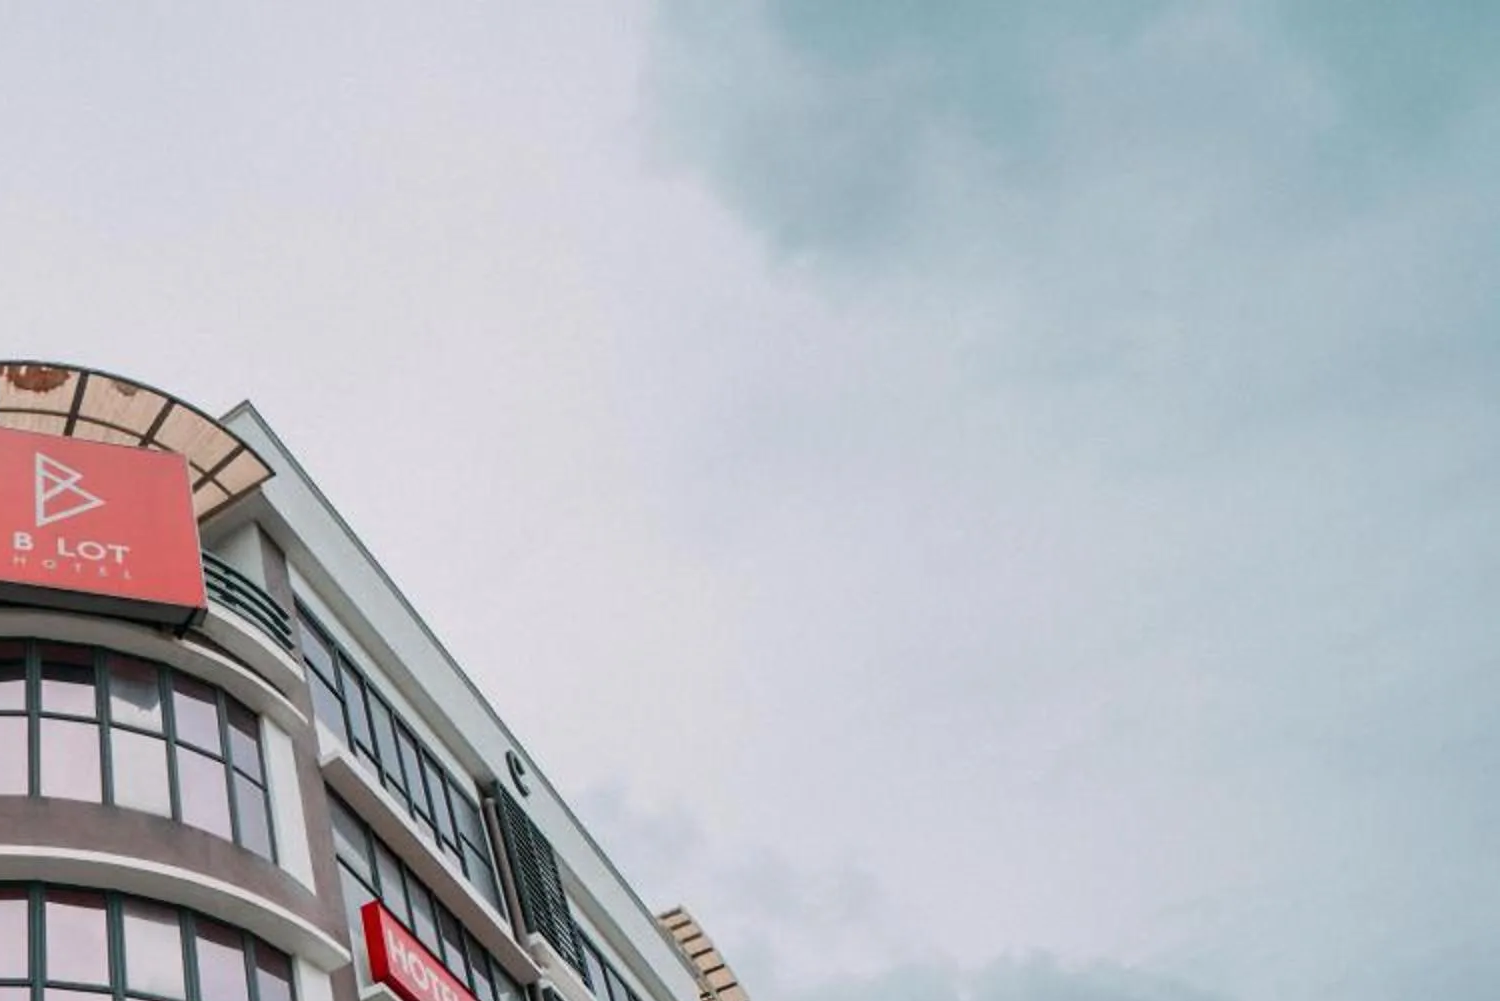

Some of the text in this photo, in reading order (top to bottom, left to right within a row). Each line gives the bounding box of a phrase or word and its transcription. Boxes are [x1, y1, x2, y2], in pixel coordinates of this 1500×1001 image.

[12, 531, 131, 564] B LOT
[12, 556, 132, 581] HOTEL
